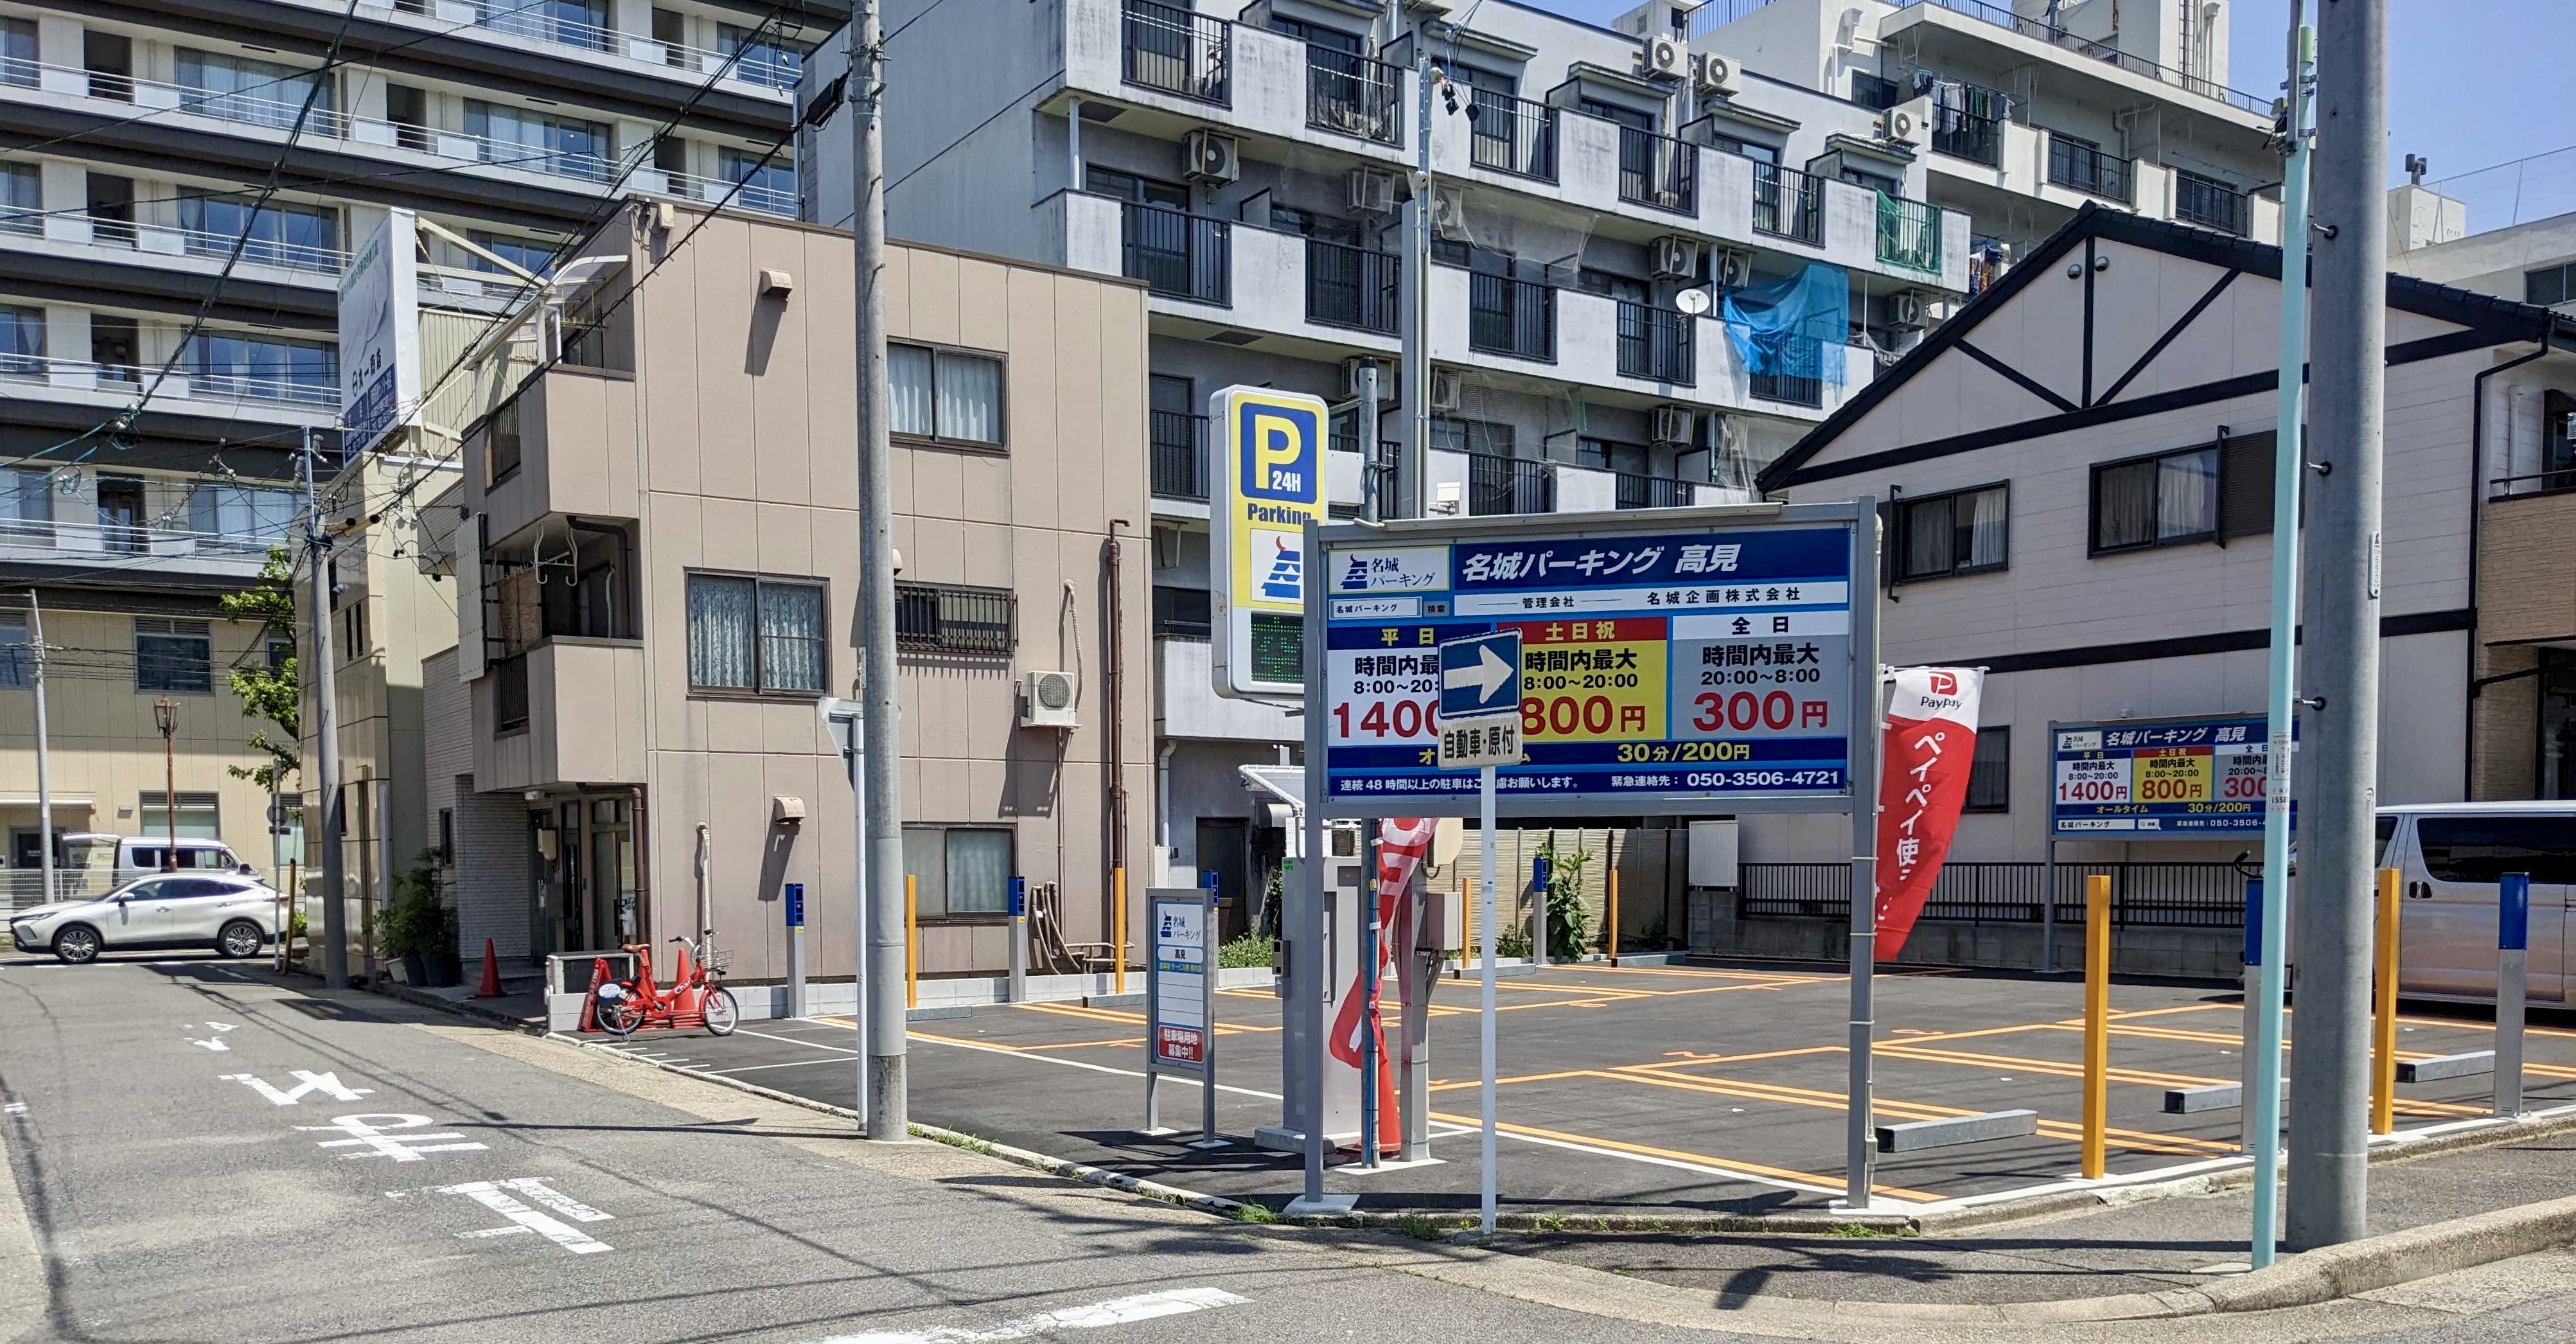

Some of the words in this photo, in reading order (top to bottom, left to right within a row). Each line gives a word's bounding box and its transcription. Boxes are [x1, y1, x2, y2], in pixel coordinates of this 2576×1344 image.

[1255, 413, 1301, 490] P
[1272, 470, 1301, 493] 24H
[1371, 557, 1399, 573] 名城
[1461, 545, 1665, 581] 名城パーキング
[1674, 544, 1742, 574] 高見
[1371, 571, 1436, 587] パーキング
[1522, 596, 1575, 609] 管理会社
[1646, 587, 1801, 606] 名城企画株式会社
[1336, 603, 1398, 614] 名城パーキング
[1545, 621, 1616, 641] 土日祝
[1525, 648, 1637, 672] 時間内最大
[1702, 642, 1820, 668] 時間内最大
[1354, 654, 1439, 677] 時間内最
[1353, 679, 1439, 694] 8:00～20:
[1920, 696, 1963, 711] PayPay
[2105, 726, 2209, 747] 名城パーキング
[2214, 726, 2246, 743] 高見
[2072, 761, 2115, 772] 時間内最大
[2149, 757, 2196, 769] 時間内最大
[1686, 771, 1839, 787] 050-3506-4721
[2096, 804, 2149, 815] オールタイム
[1174, 948, 1186, 960] 高見
